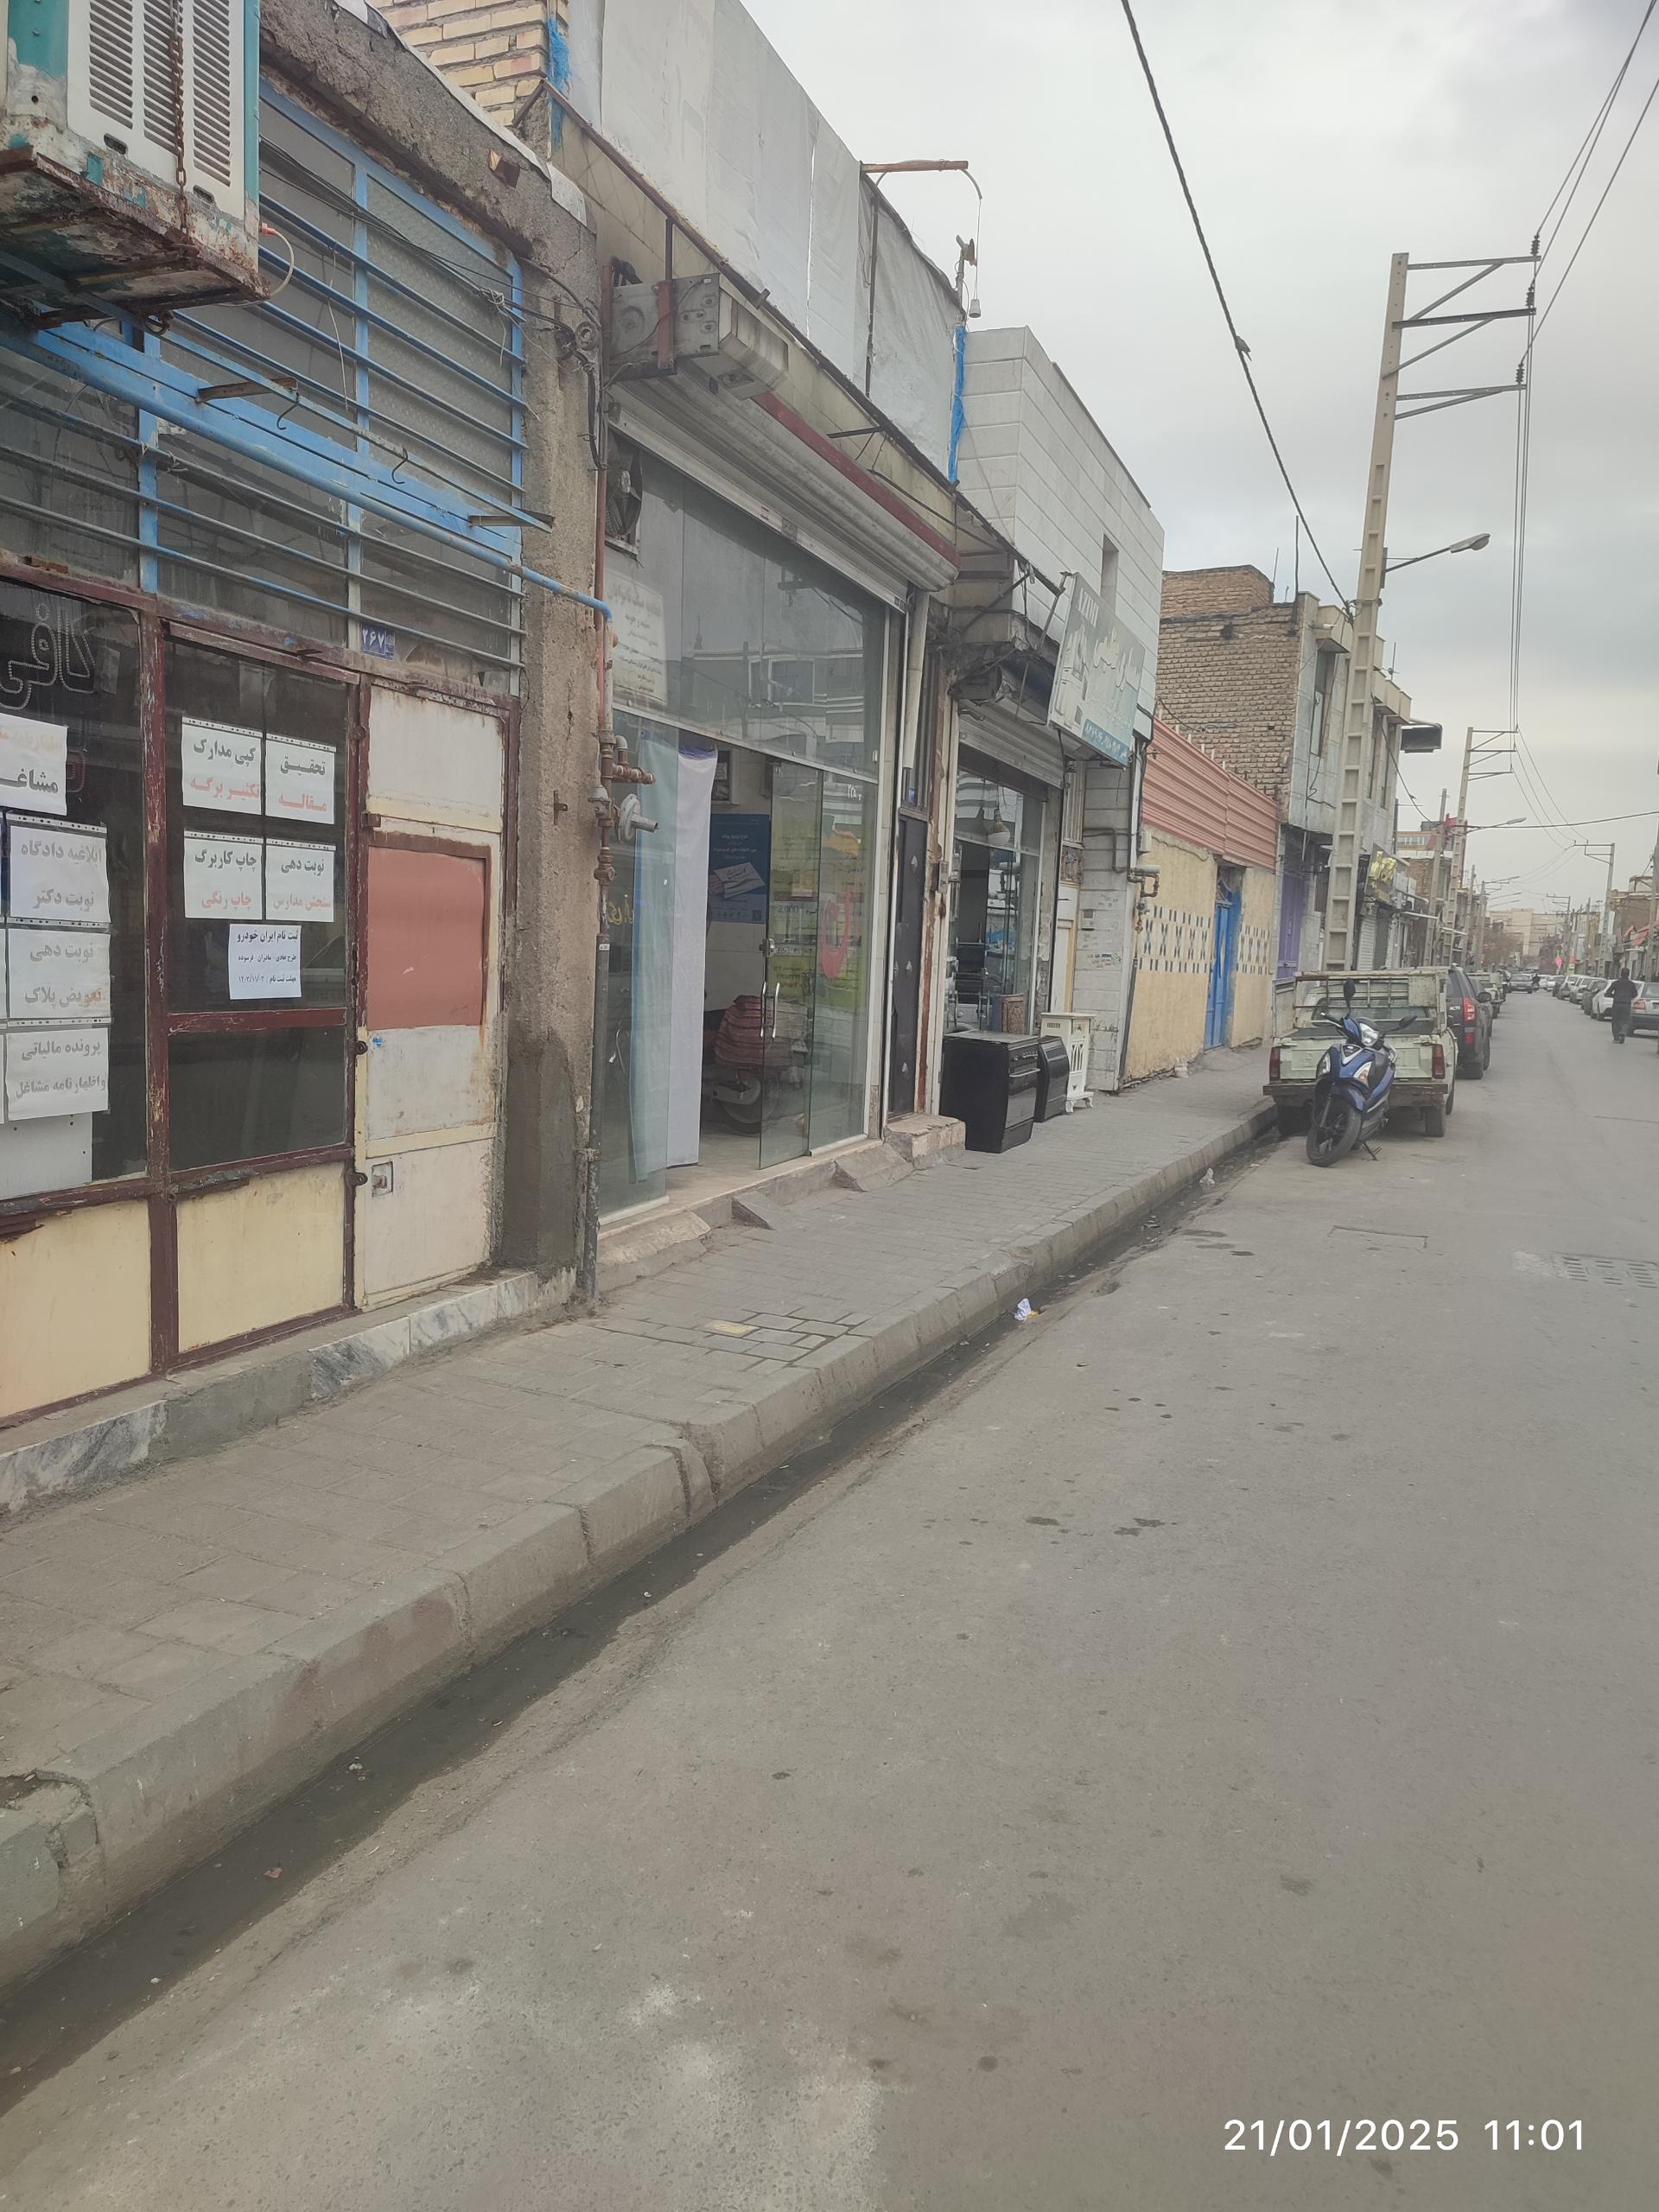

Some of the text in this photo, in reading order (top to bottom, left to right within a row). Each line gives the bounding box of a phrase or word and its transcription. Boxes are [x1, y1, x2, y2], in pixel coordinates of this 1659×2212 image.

[363, 628, 385, 649] ۲۶۷
[194, 739, 232, 761] مدارک
[280, 756, 326, 776] تحقیق
[191, 777, 260, 801] تکثیر برگه
[278, 793, 327, 811] مقاله
[21, 838, 102, 868] ابلاغیه دادگاه
[235, 851, 257, 872] چاپ
[281, 857, 326, 877] نوبت دهی
[33, 888, 94, 912] نوبت دکتر
[201, 890, 252, 912] چاپ رنگی
[272, 893, 304, 911] مدارس
[237, 929, 299, 944] ثبت نام ایران خودرو
[29, 941, 94, 964] نوبت دهی
[25, 986, 103, 1010] تعویض پلاک
[21, 1038, 101, 1062] پرونده مالیاتی
[16, 1078, 50, 1099] مشاغل
